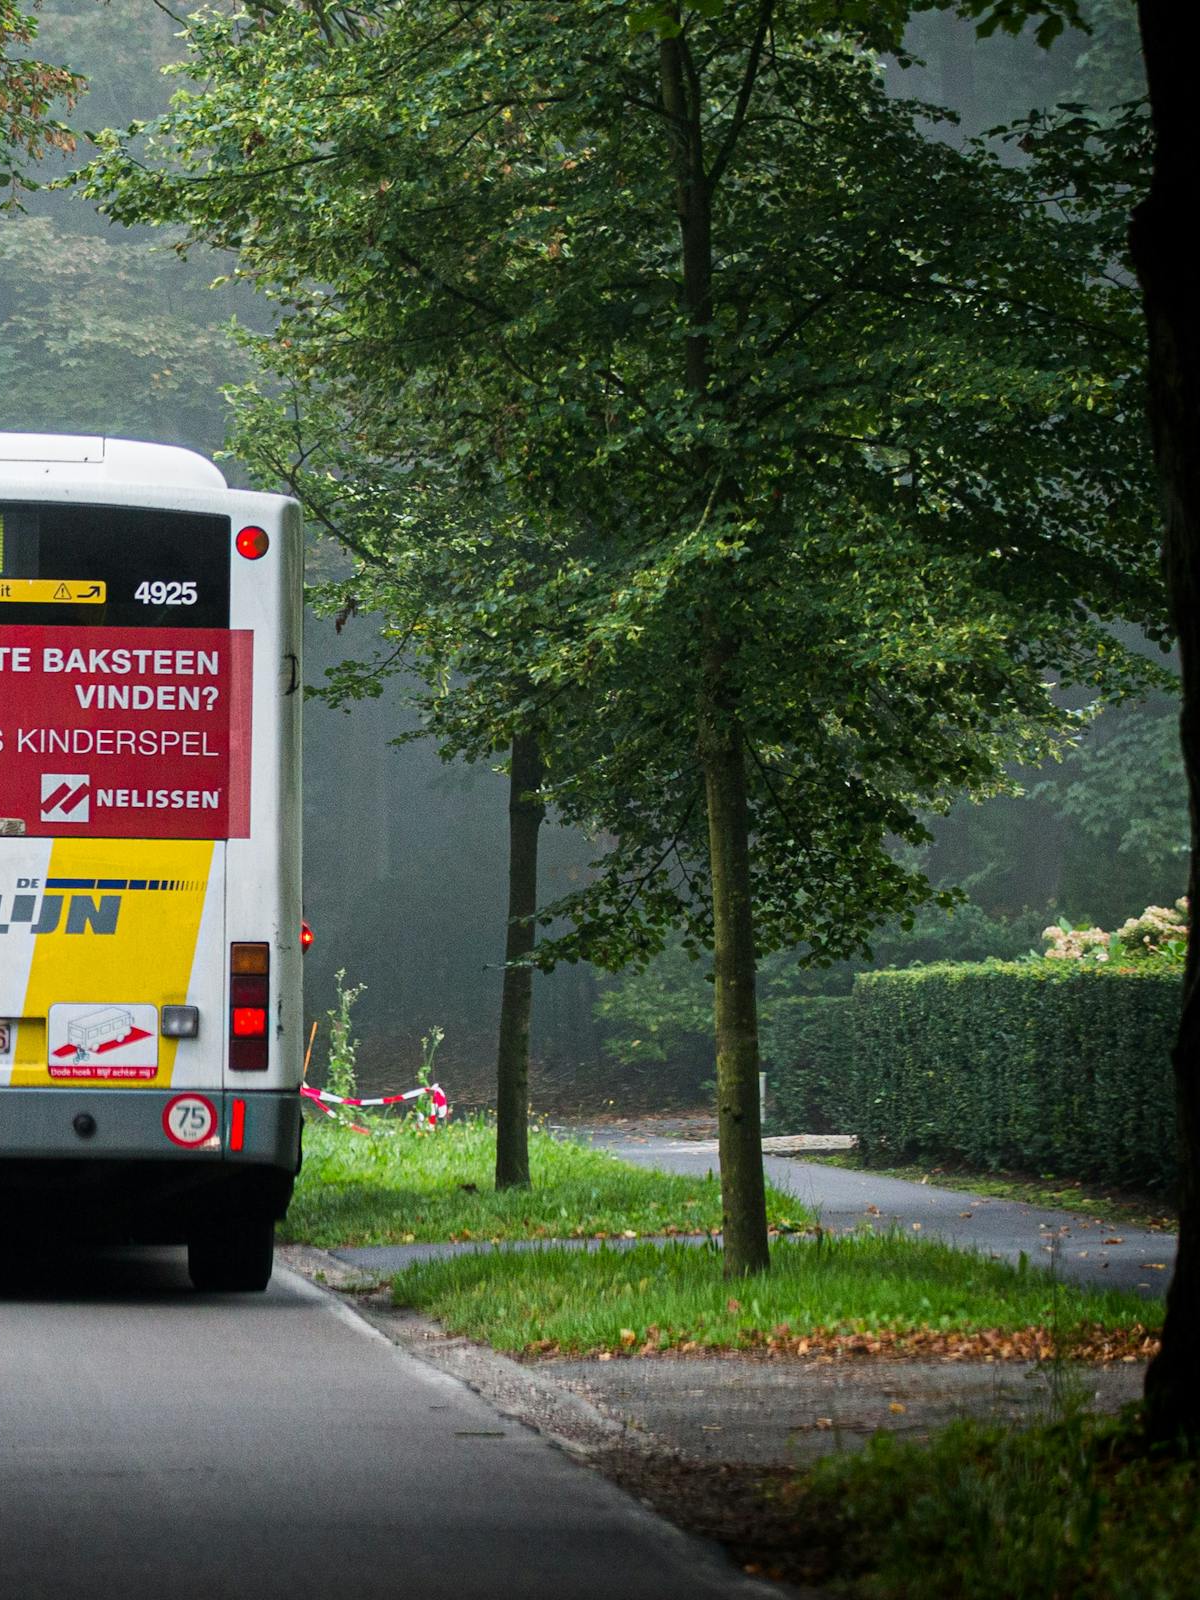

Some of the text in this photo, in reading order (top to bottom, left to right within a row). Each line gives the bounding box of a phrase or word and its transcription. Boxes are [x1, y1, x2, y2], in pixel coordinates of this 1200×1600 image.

[134, 581, 198, 605] 4925
[43, 648, 219, 676] BAKSTEEN
[75, 685, 220, 711] VINDEN?
[17, 729, 220, 757] KINDERSPEL
[96, 789, 220, 809] NELISSEN
[16, 878, 40, 889] DE
[176, 1106, 205, 1129] 75
